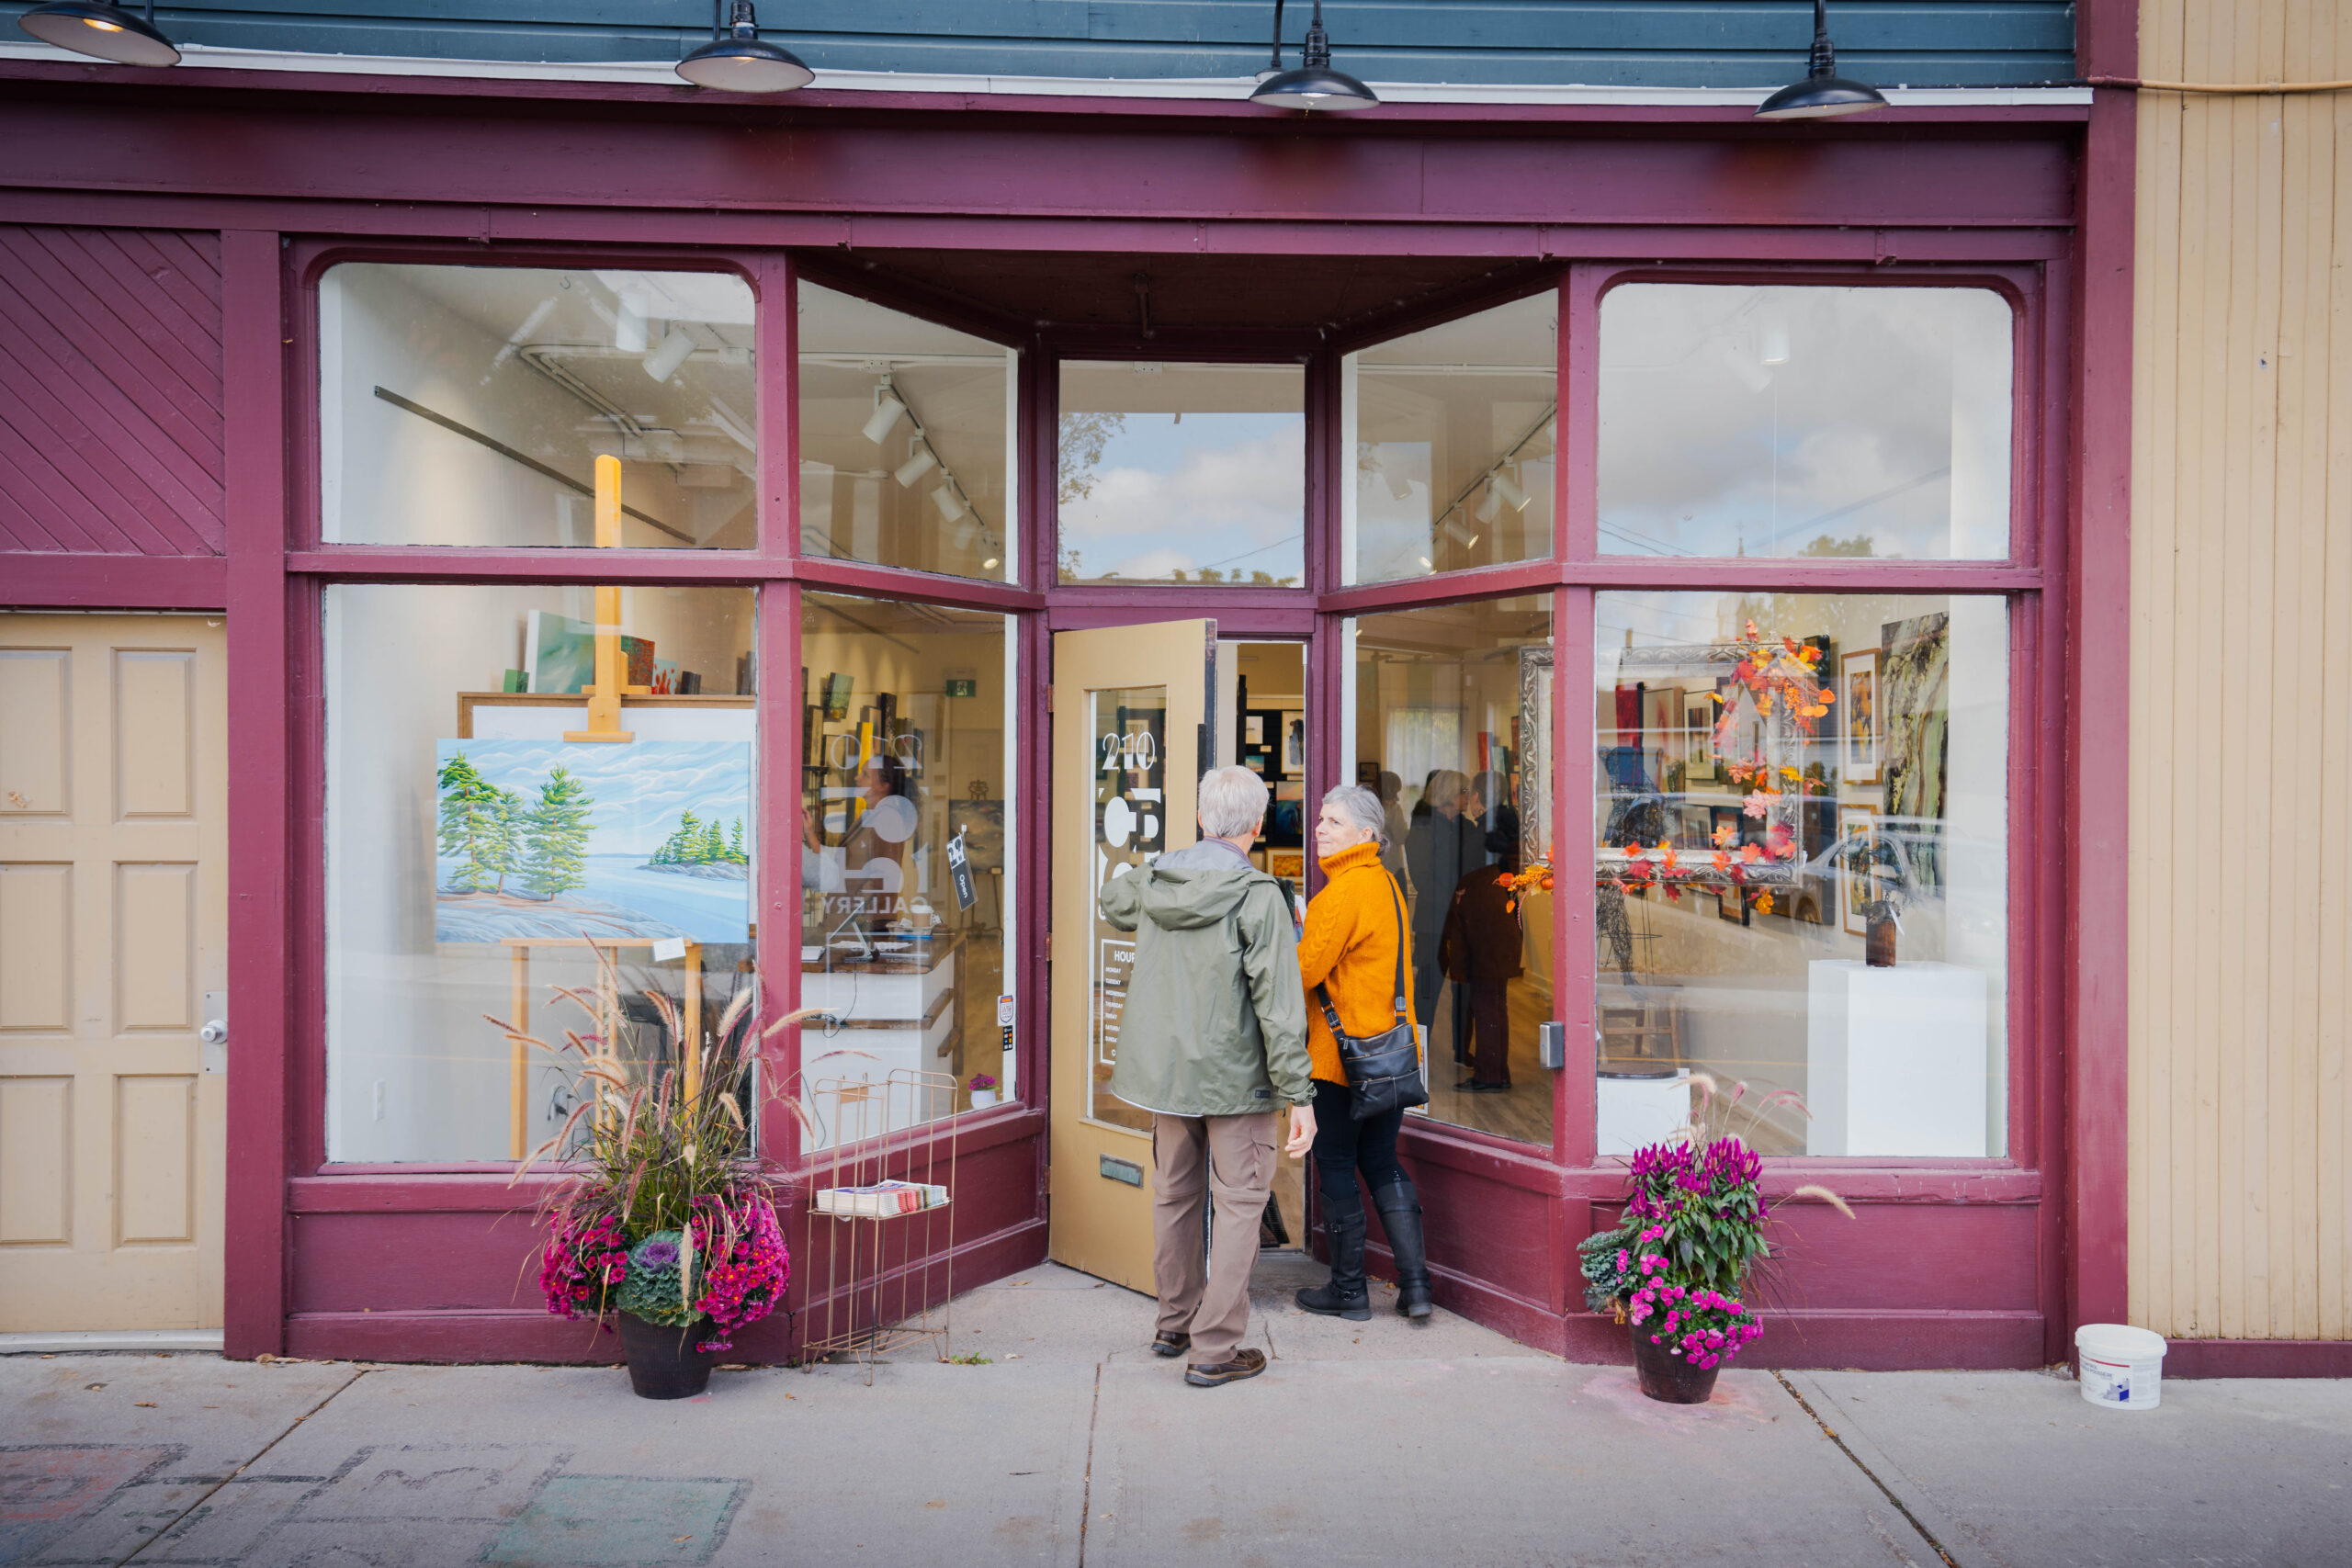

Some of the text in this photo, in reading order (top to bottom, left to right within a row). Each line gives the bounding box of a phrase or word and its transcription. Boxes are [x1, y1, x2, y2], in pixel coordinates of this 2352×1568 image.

[1102, 731, 1156, 770] 210
[959, 874, 968, 898] Open
[1105, 977, 1121, 986] TUESDAY
[1105, 989, 1126, 998] WEDNESDAY
[1105, 1000, 1123, 1009] THURSDAY
